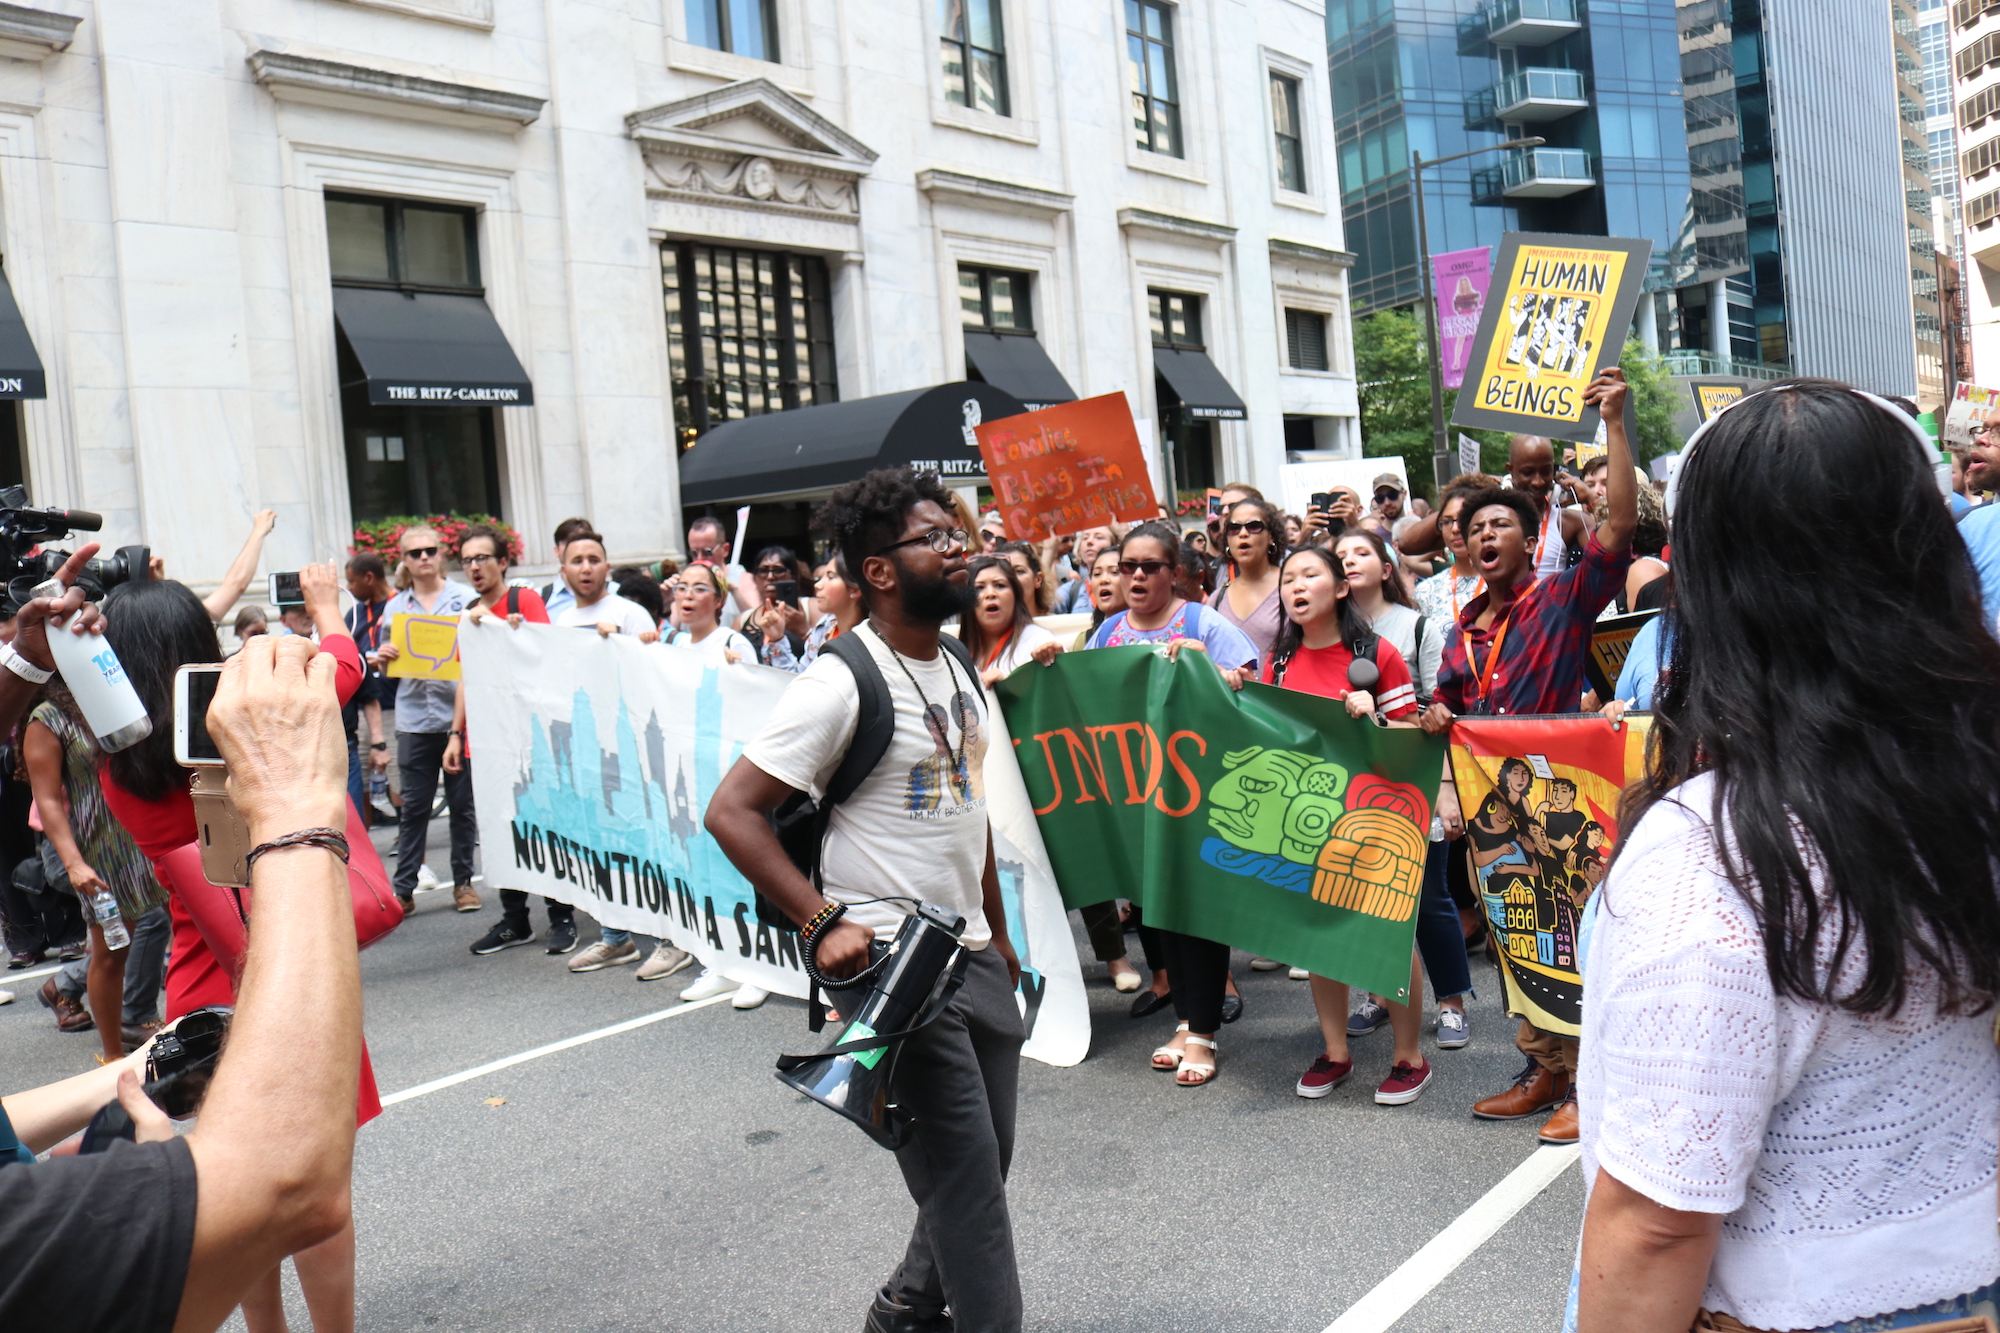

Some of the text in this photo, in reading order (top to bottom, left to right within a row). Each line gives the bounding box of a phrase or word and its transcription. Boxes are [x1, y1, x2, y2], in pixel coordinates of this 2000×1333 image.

[1528, 247, 1613, 262] IMMIGRANTS ARE
[1519, 256, 1610, 296] HUMAN
[386, 386, 418, 400] THE
[1485, 375, 1577, 418] BEINGS.
[987, 424, 1079, 467] Families
[1077, 455, 1125, 487] In
[927, 809, 941, 819] MY
[511, 820, 546, 874] NO
[546, 830, 674, 922] DETENTION
[673, 876, 701, 939] IN
[704, 896, 724, 951] A
